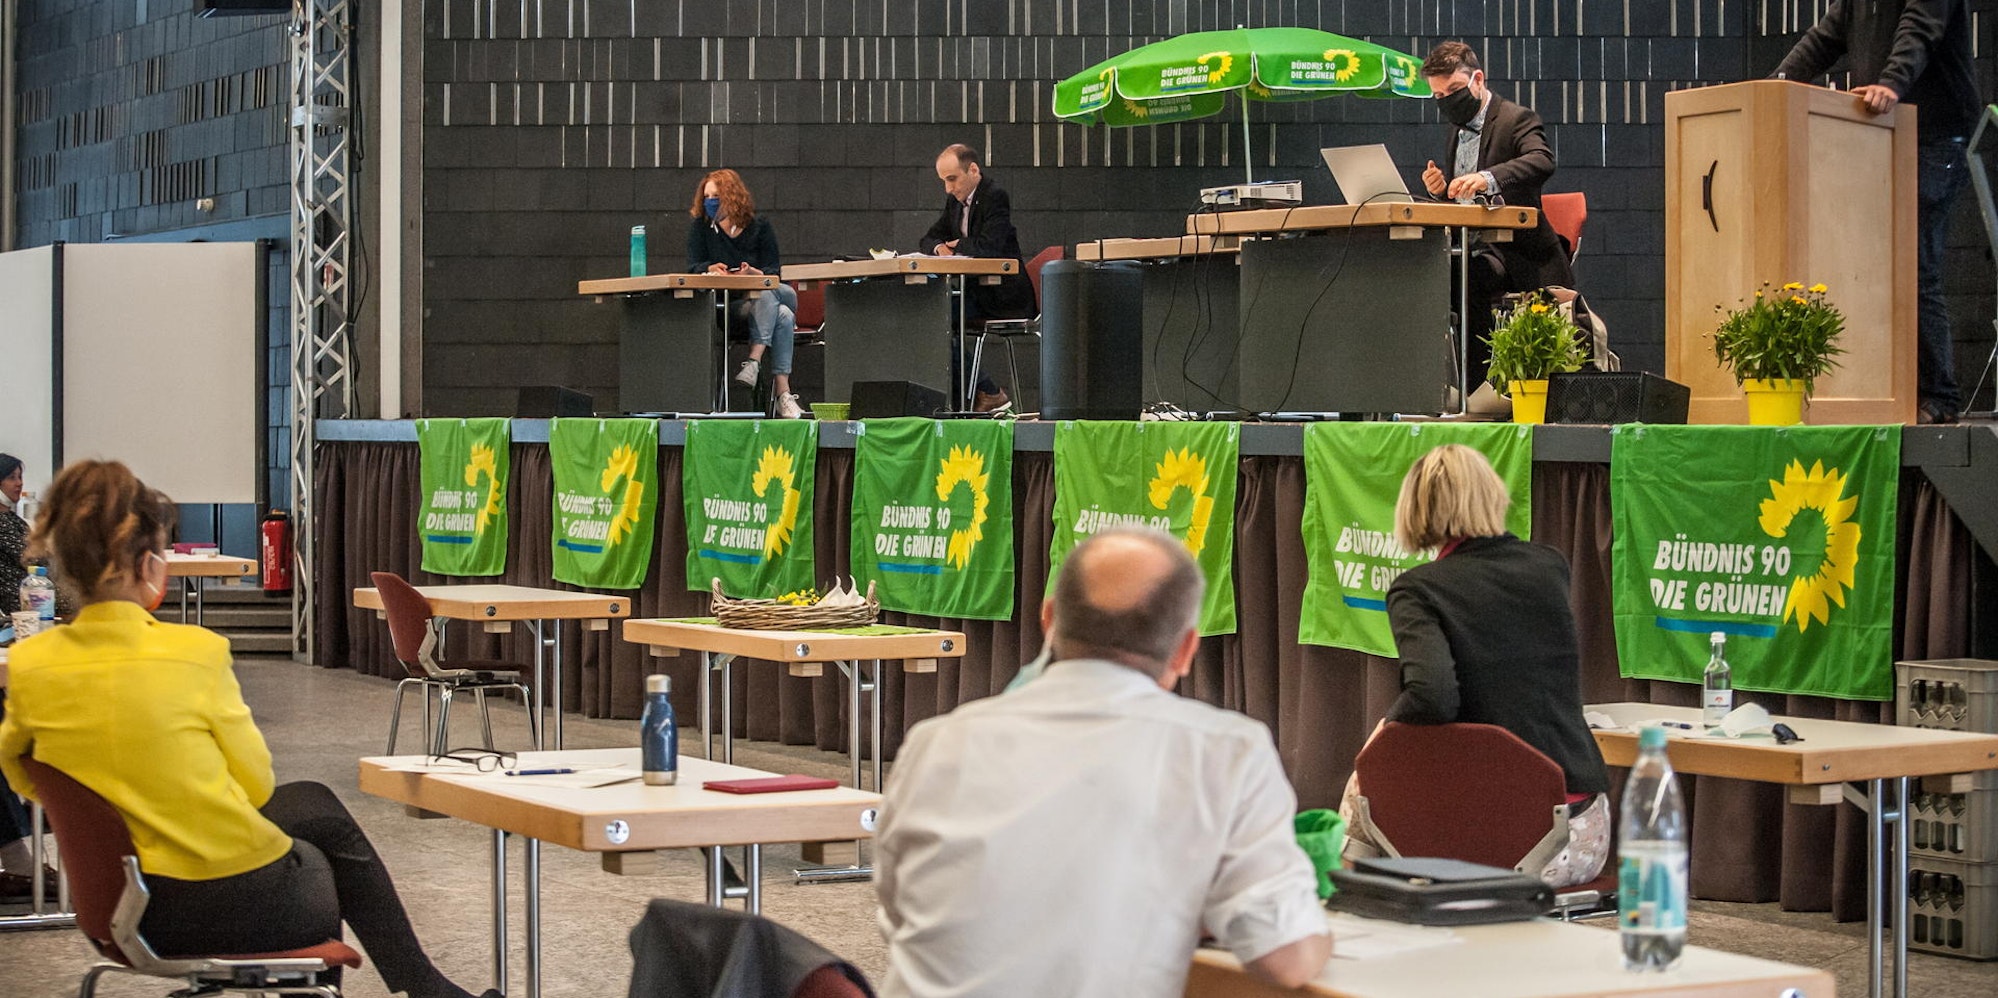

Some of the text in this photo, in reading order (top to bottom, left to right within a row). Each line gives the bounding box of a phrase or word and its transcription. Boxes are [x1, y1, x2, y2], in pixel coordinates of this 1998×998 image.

[1161, 65, 1209, 78] BÜNDNIS 90
[1290, 69, 1335, 80] DIE GRÜNEN
[1291, 60, 1335, 70] BÜNDNIS 90
[1160, 74, 1208, 87] DIE GRÜNEN
[465, 491, 477, 508] 90
[597, 497, 612, 516] 90
[753, 502, 767, 523] 90
[881, 500, 951, 529] BÜNDNIS 90
[720, 522, 765, 551] GRÜNEN
[875, 529, 947, 559] DIE GRÜNEN
[1653, 533, 1791, 576] BÜNDNIS 90
[1333, 559, 1366, 590] DIE
[1650, 575, 1787, 616] DIE GRÜNEN
